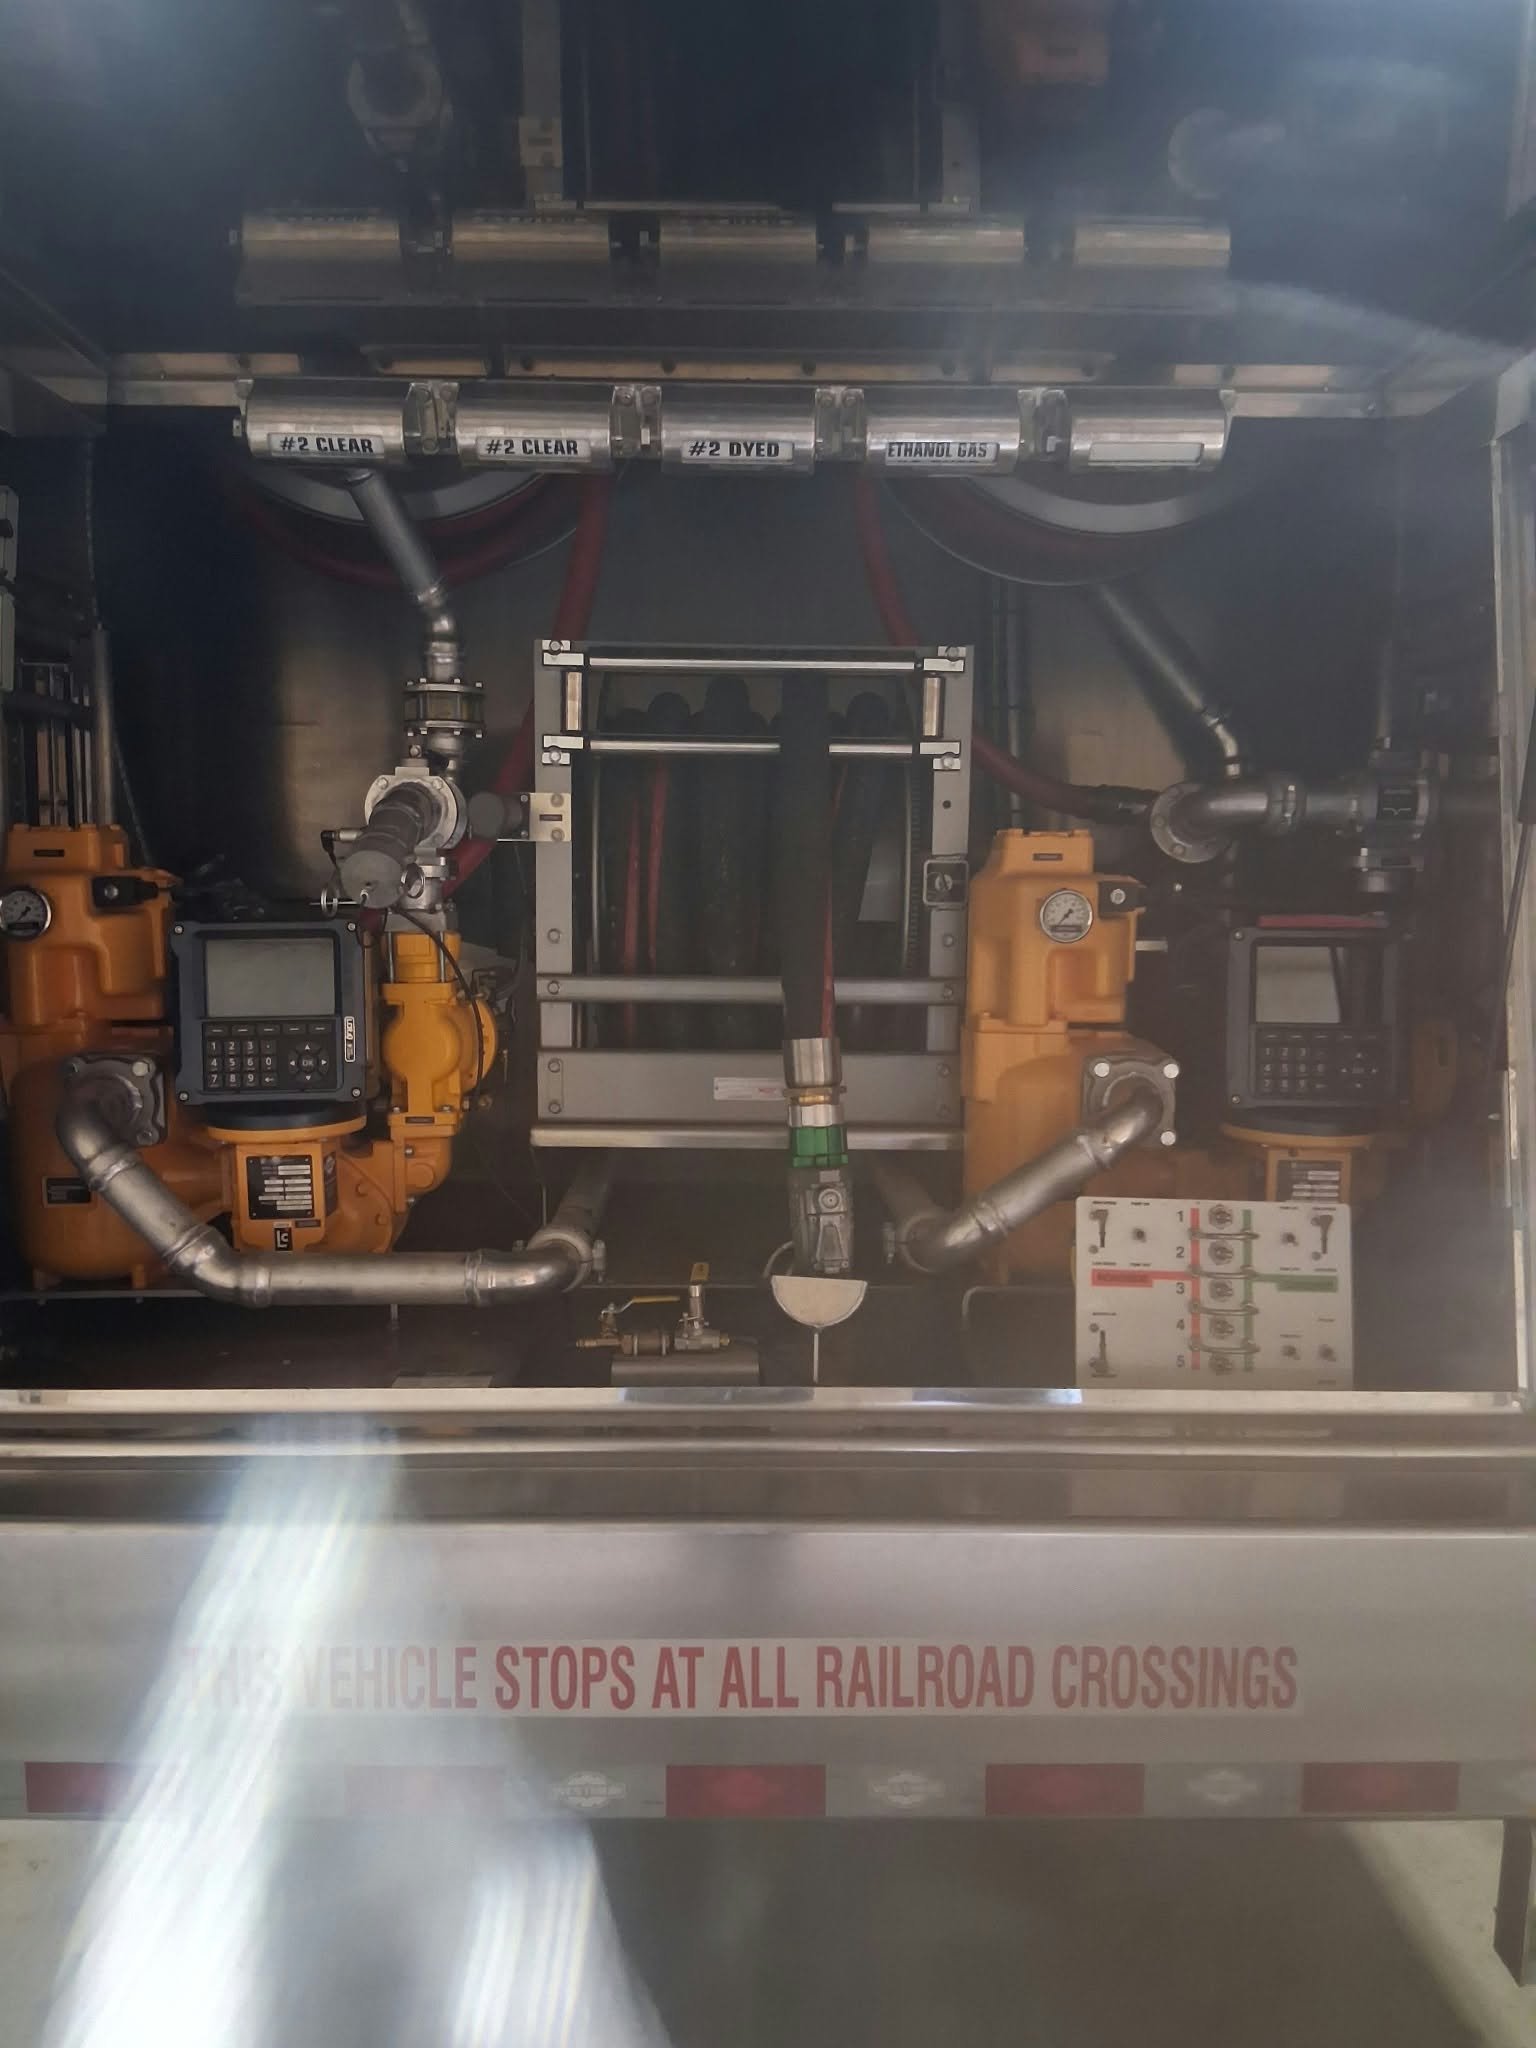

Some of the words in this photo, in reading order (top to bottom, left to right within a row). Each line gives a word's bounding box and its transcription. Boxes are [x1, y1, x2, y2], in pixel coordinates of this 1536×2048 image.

[280, 436, 309, 451] #2
[316, 437, 374, 453] CLEAR
[486, 440, 515, 455] #2
[522, 439, 578, 455] CLEAR
[688, 441, 720, 457] #2
[729, 441, 780, 457] DYED
[887, 441, 952, 458] ETHANOL
[957, 442, 987, 458] GAS
[228, 1041, 236, 1050] 2
[247, 1041, 254, 1050] 3
[210, 1058, 217, 1067] 4
[229, 1058, 236, 1067] 5
[211, 1074, 218, 1083] 7
[229, 1074, 236, 1083] 8
[247, 1074, 254, 1083] 9
[1177, 1210, 1184, 1222] 1
[1176, 1246, 1184, 1258] 2
[1176, 1282, 1185, 1294] 3
[1176, 1319, 1185, 1331] 4
[297, 1646, 478, 1709] VEHICLE
[495, 1645, 636, 1710] STOPS
[651, 1646, 704, 1708] AT
[718, 1646, 799, 1708] ALL
[816, 1645, 1034, 1710] RAILROAD
[1052, 1645, 1297, 1710] CROSSINGS
